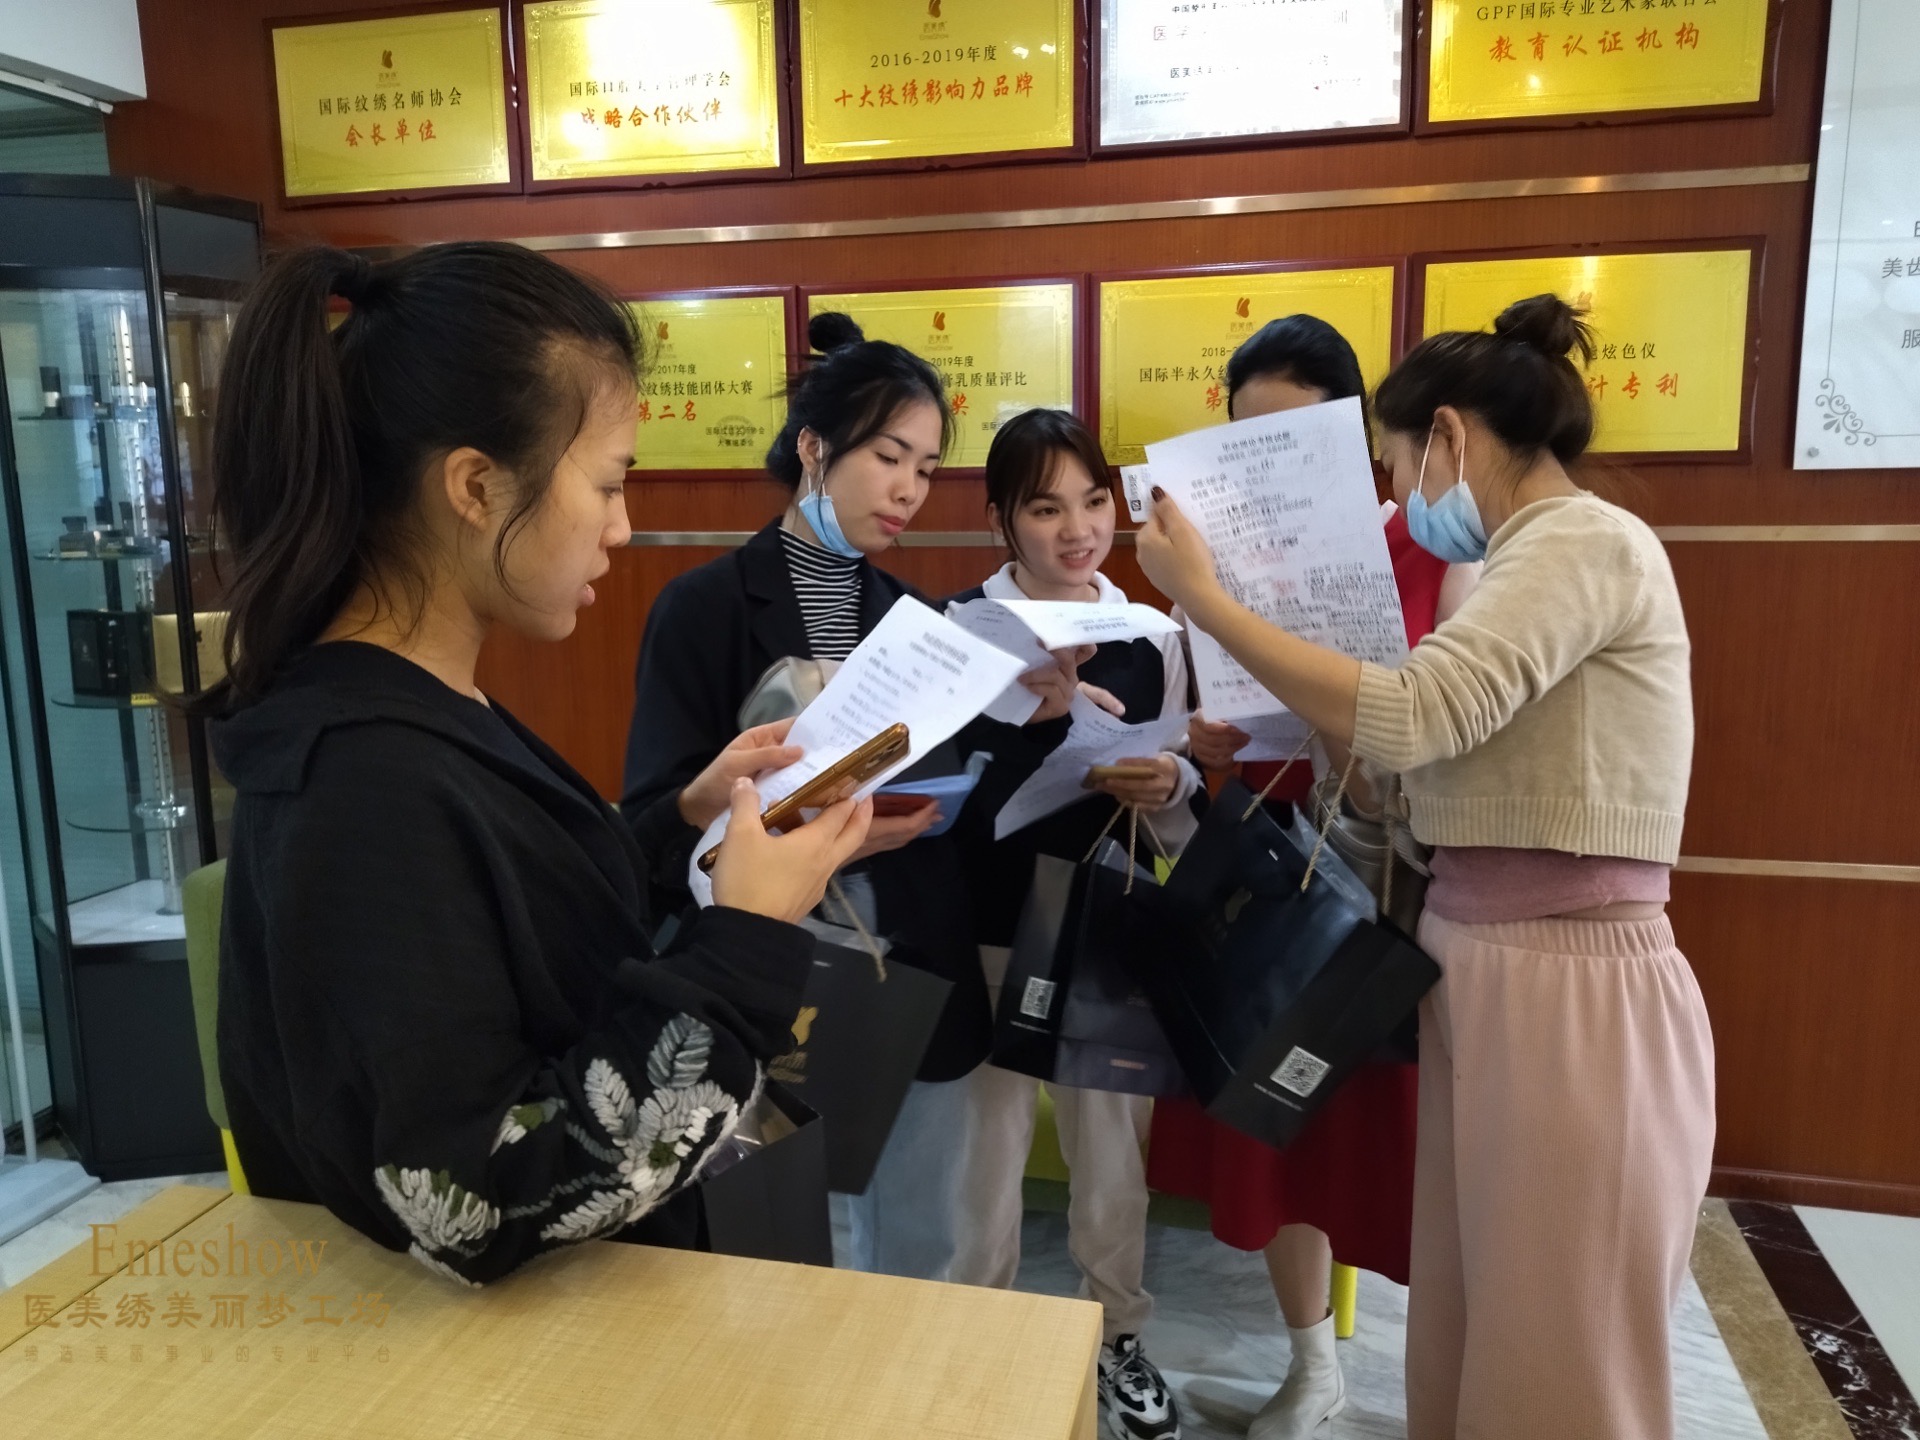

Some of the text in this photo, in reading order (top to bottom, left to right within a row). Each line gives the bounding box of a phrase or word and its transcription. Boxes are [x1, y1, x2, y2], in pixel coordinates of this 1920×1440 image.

[870, 45, 998, 68] 2016-2019年度
[1489, 22, 1700, 63] 教育认证机构
[318, 86, 462, 116] 国际纹绣名师协会
[834, 71, 1034, 108] 十大纹绣影响力品牌
[345, 118, 437, 147] 会长单位
[640, 380, 753, 396] 纹绣技能团体大赛
[638, 399, 697, 424] 第二名
